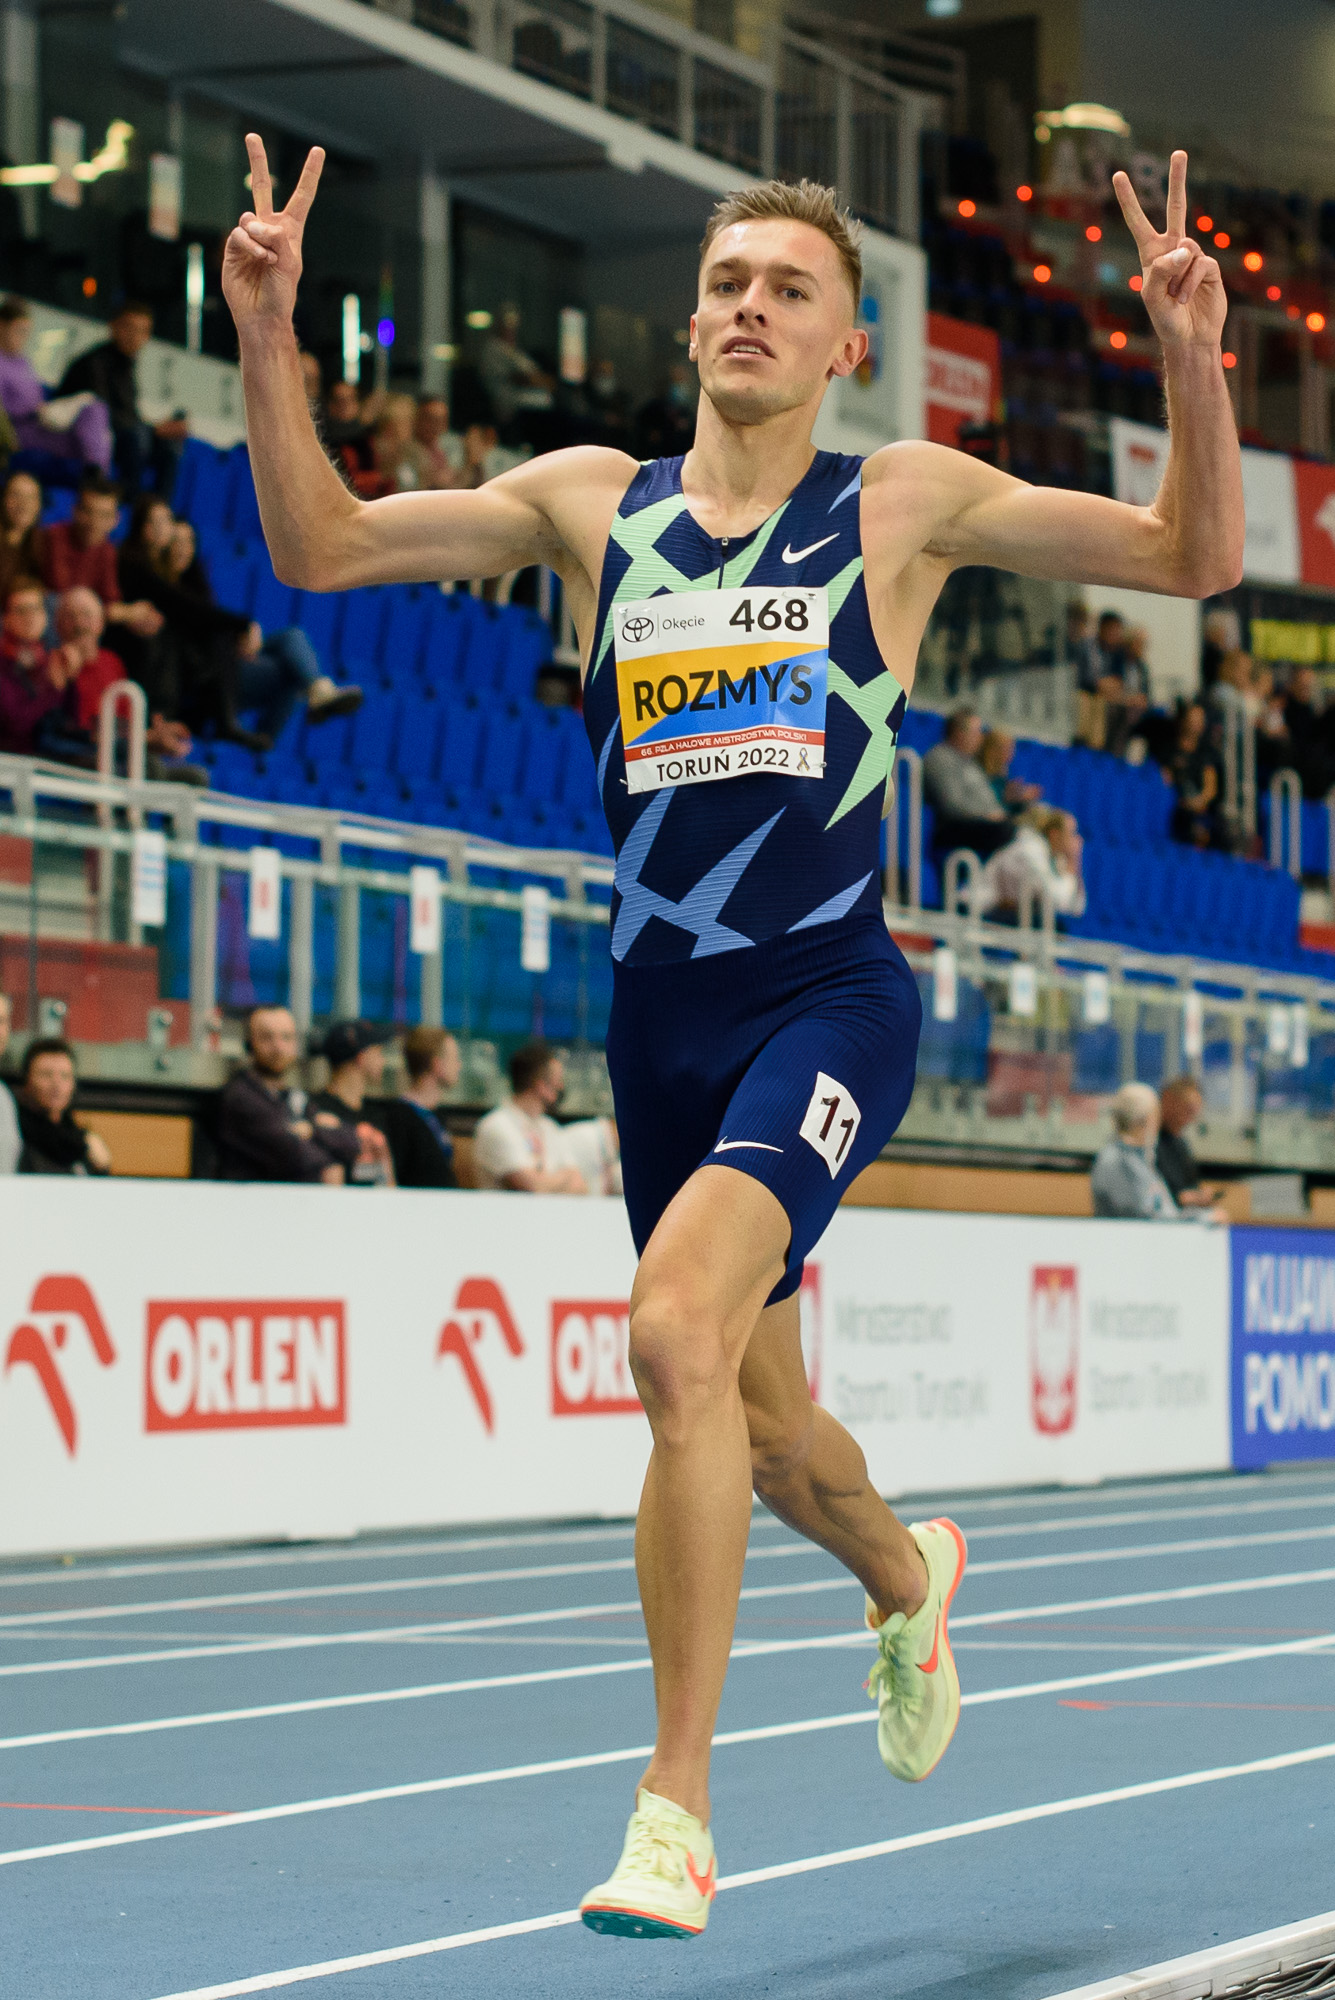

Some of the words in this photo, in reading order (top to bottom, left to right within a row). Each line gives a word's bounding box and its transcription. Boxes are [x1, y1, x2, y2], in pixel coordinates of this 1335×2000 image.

[662, 615, 705, 631] Okęcie
[729, 598, 809, 632] 468
[633, 664, 812, 721] ROZMYS
[655, 743, 675, 753] PZLA
[676, 738, 712, 749] HALOWE
[713, 729, 776, 745] MISTRZOSTWA
[778, 729, 807, 741] POLSKI
[657, 749, 729, 781] TORUŃ
[738, 747, 789, 768] 2022
[820, 1095, 855, 1164] 11
[151, 1313, 338, 1418] ORLEN
